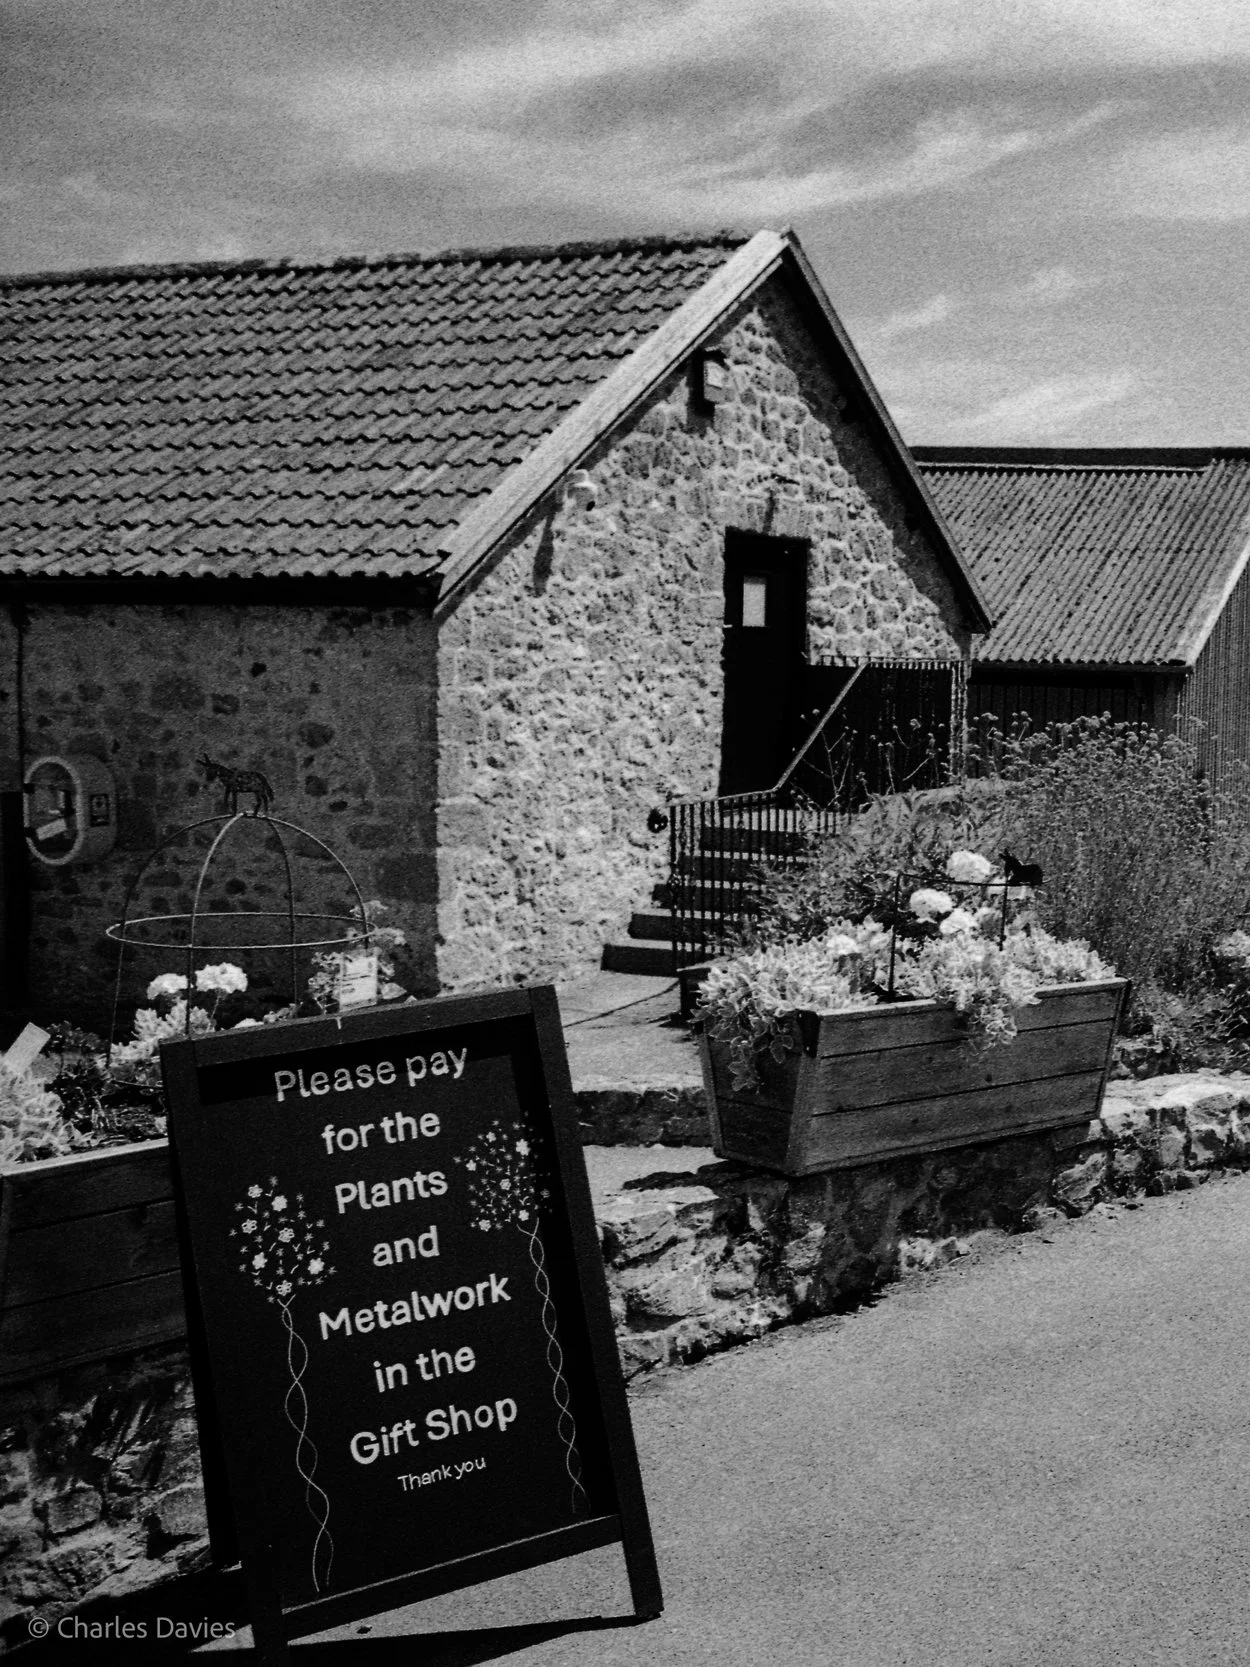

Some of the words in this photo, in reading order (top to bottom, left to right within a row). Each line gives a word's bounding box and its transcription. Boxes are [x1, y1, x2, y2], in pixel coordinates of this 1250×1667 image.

[274, 1061, 397, 1102] Please
[405, 1047, 468, 1087] pay
[321, 1123, 376, 1154] for
[380, 1111, 441, 1144] the
[334, 1170, 449, 1214] Plants
[372, 1224, 441, 1267] and
[318, 1272, 512, 1341] Metalwork
[372, 1360, 409, 1393] in
[415, 1346, 476, 1381] the
[349, 1419, 420, 1465] Gift
[424, 1397, 518, 1441] Shop
[397, 1464, 453, 1491] Thank
[454, 1457, 487, 1480] you
